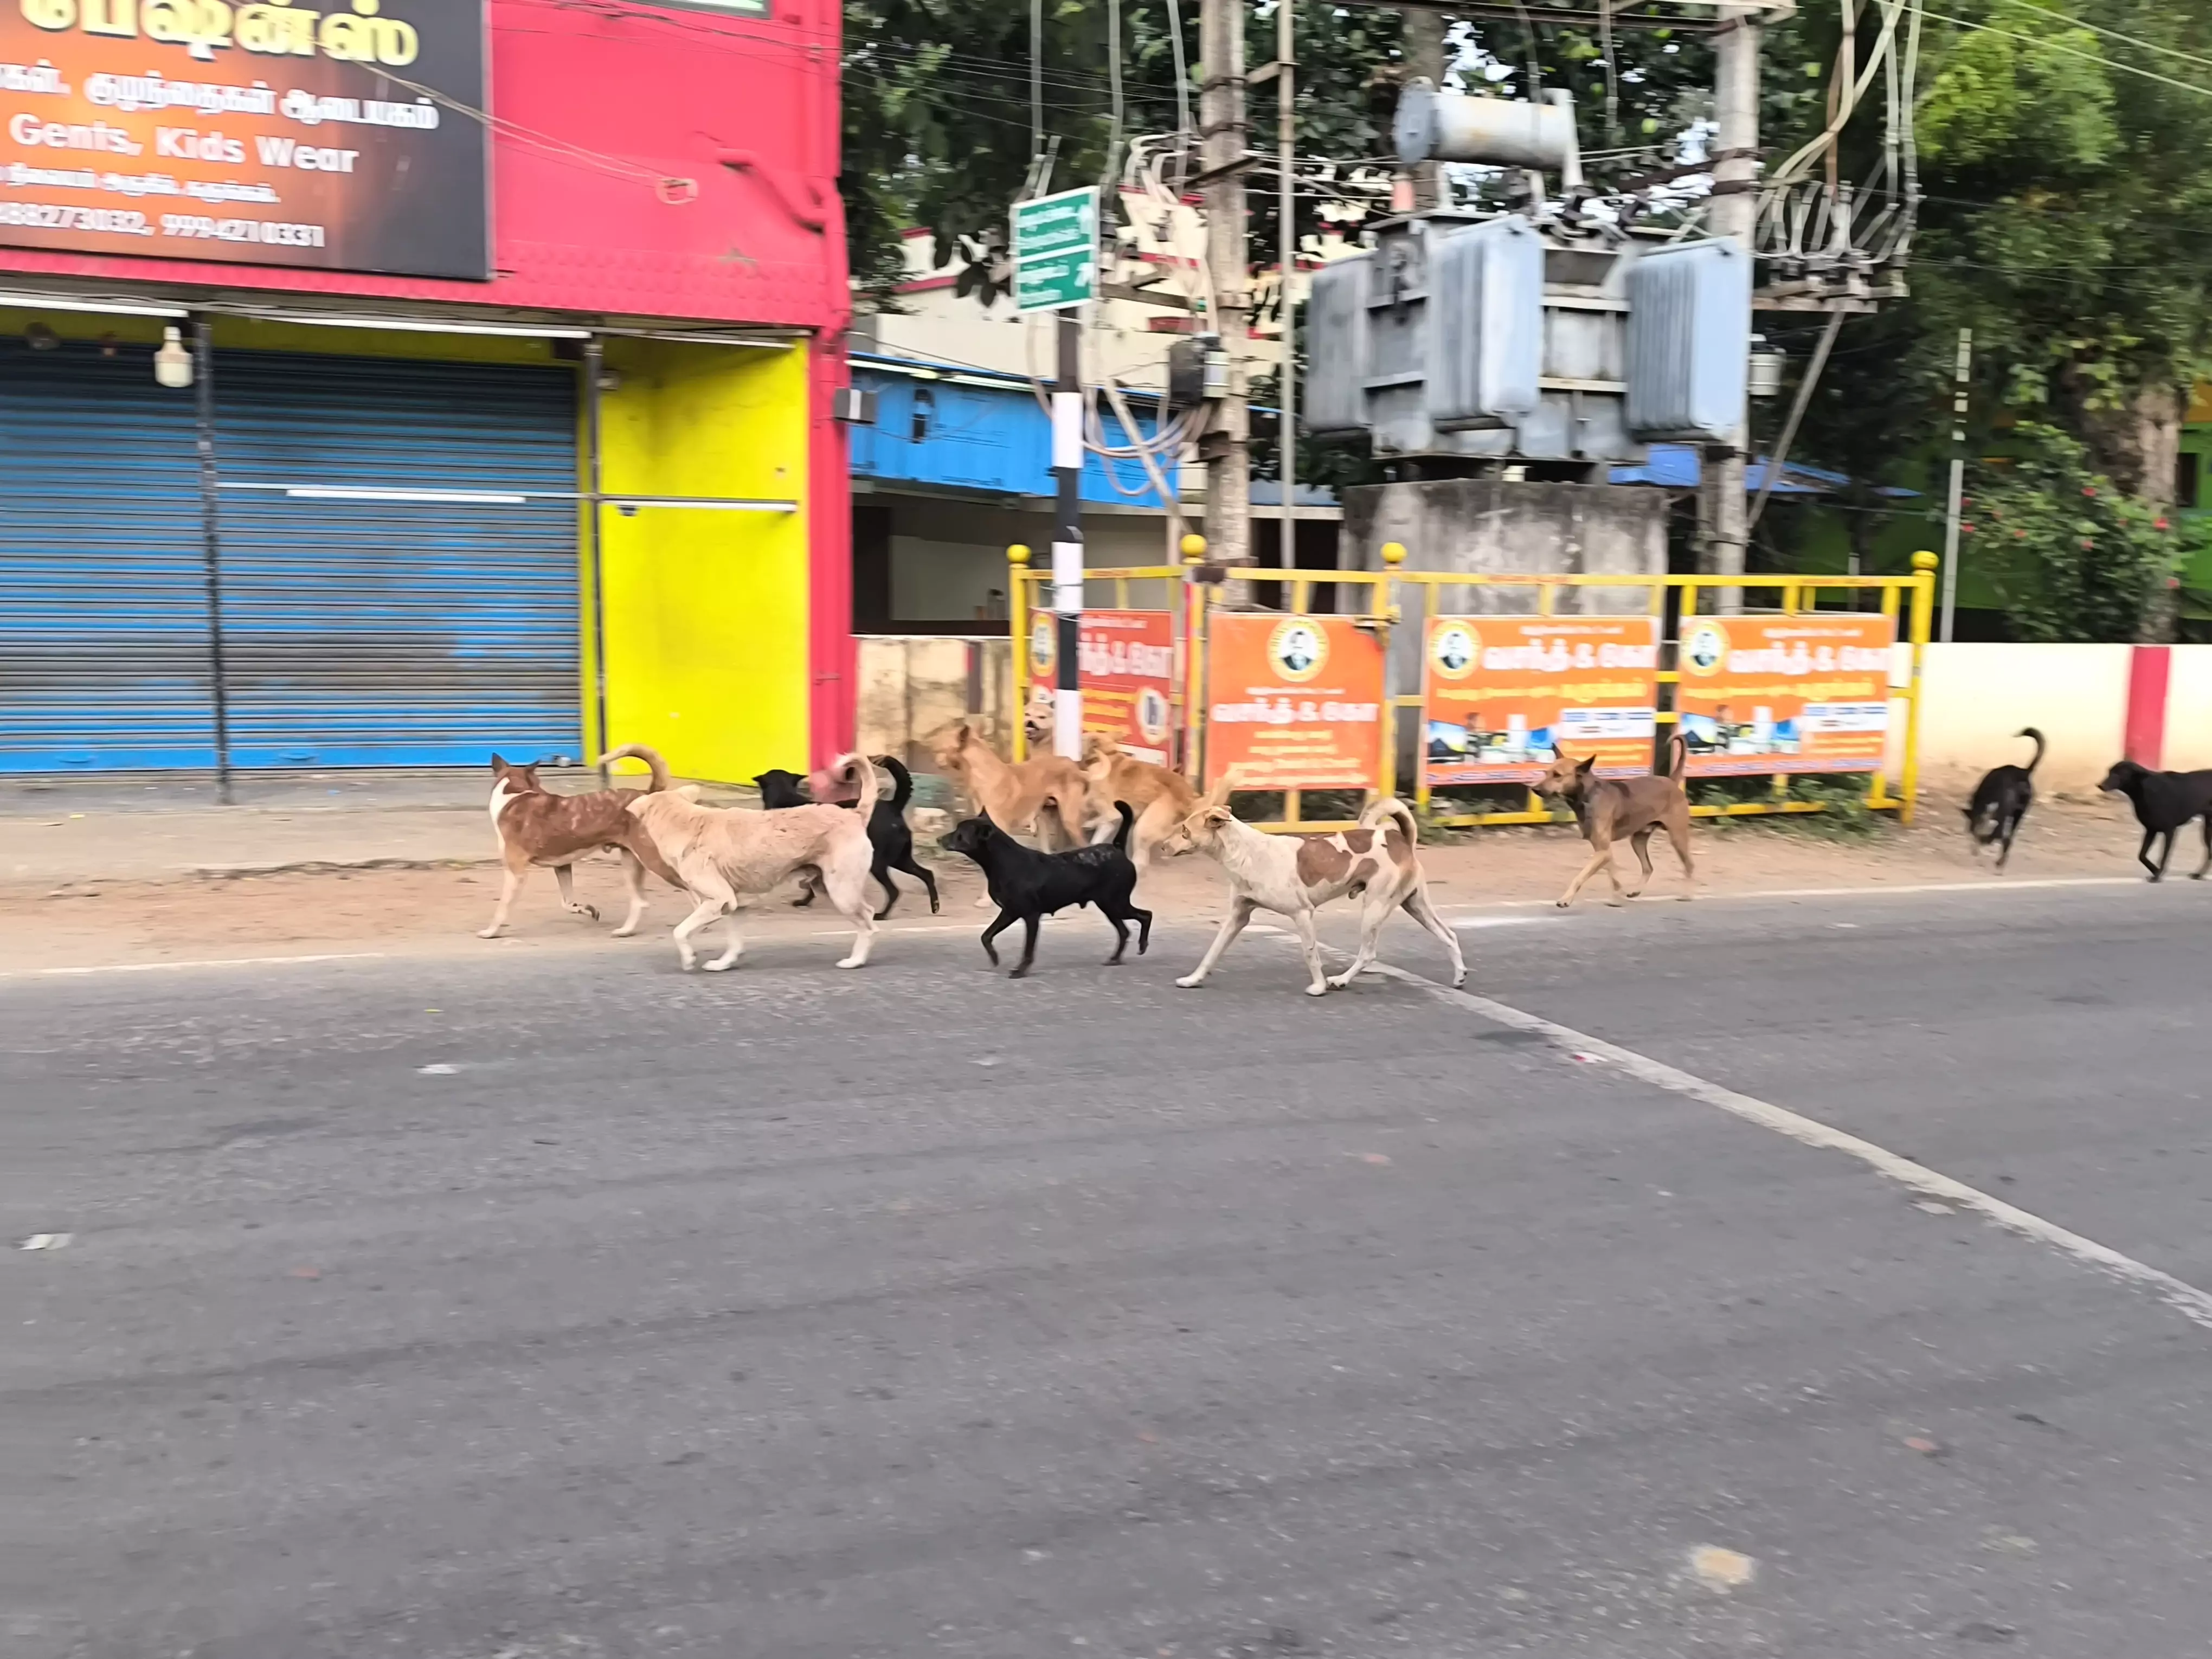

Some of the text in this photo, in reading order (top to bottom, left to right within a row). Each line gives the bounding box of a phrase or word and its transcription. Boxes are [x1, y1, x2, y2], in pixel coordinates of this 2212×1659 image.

[83, 69, 277, 115] குழந்தைகள்
[279, 88, 440, 130] ஆடையகம்
[9, 113, 359, 173] Gents, Kids Wear
[159, 213, 325, 248] 9994210331
